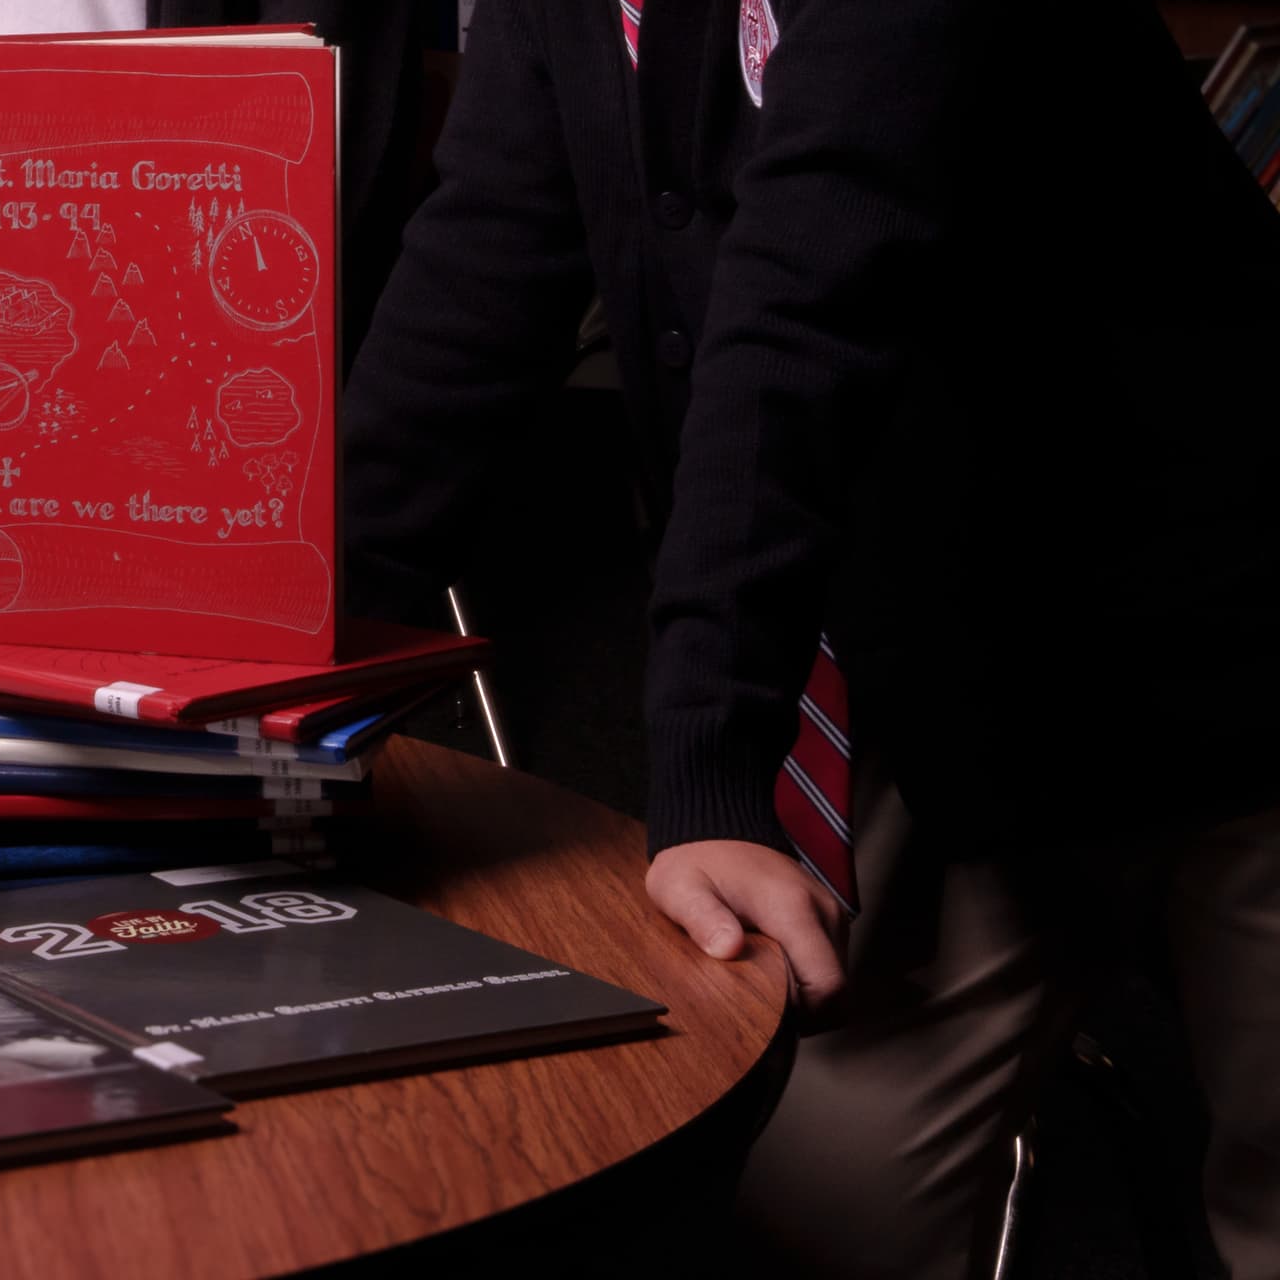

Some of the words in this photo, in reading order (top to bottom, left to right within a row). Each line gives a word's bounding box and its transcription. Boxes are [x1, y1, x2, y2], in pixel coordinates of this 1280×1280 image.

[21, 158, 121, 191] Maria
[132, 160, 244, 192] Goretti
[71, 500, 115, 521] we
[124, 489, 209, 524] there
[217, 497, 285, 540] yet?
[109, 919, 199, 939] Faith
